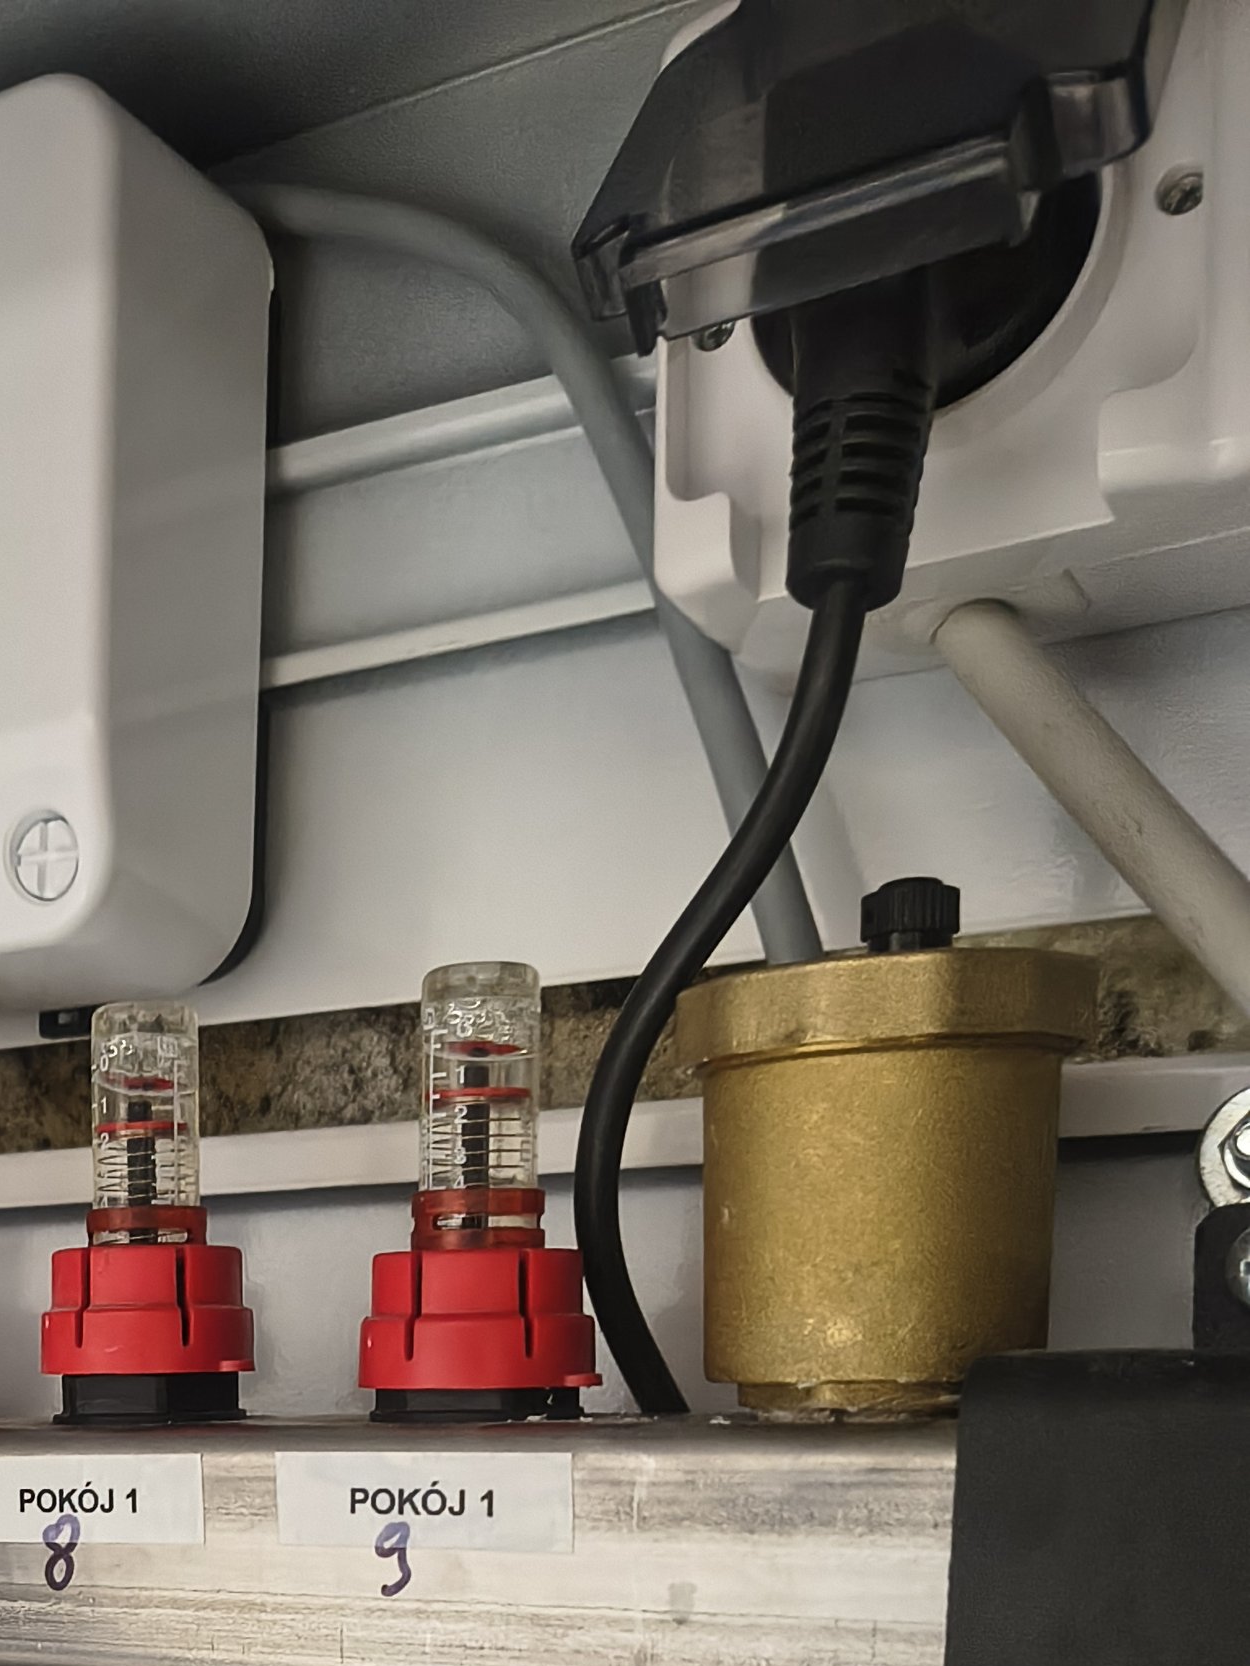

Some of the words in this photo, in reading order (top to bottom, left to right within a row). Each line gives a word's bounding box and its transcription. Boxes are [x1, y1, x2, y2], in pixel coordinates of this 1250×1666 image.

[19, 1481, 114, 1514] POKÓJ
[125, 1488, 137, 1514] 1
[350, 1480, 466, 1517] POKÓJ
[480, 1489, 494, 1518] 1
[42, 1513, 81, 1591] 8
[374, 1521, 412, 1597] 9
